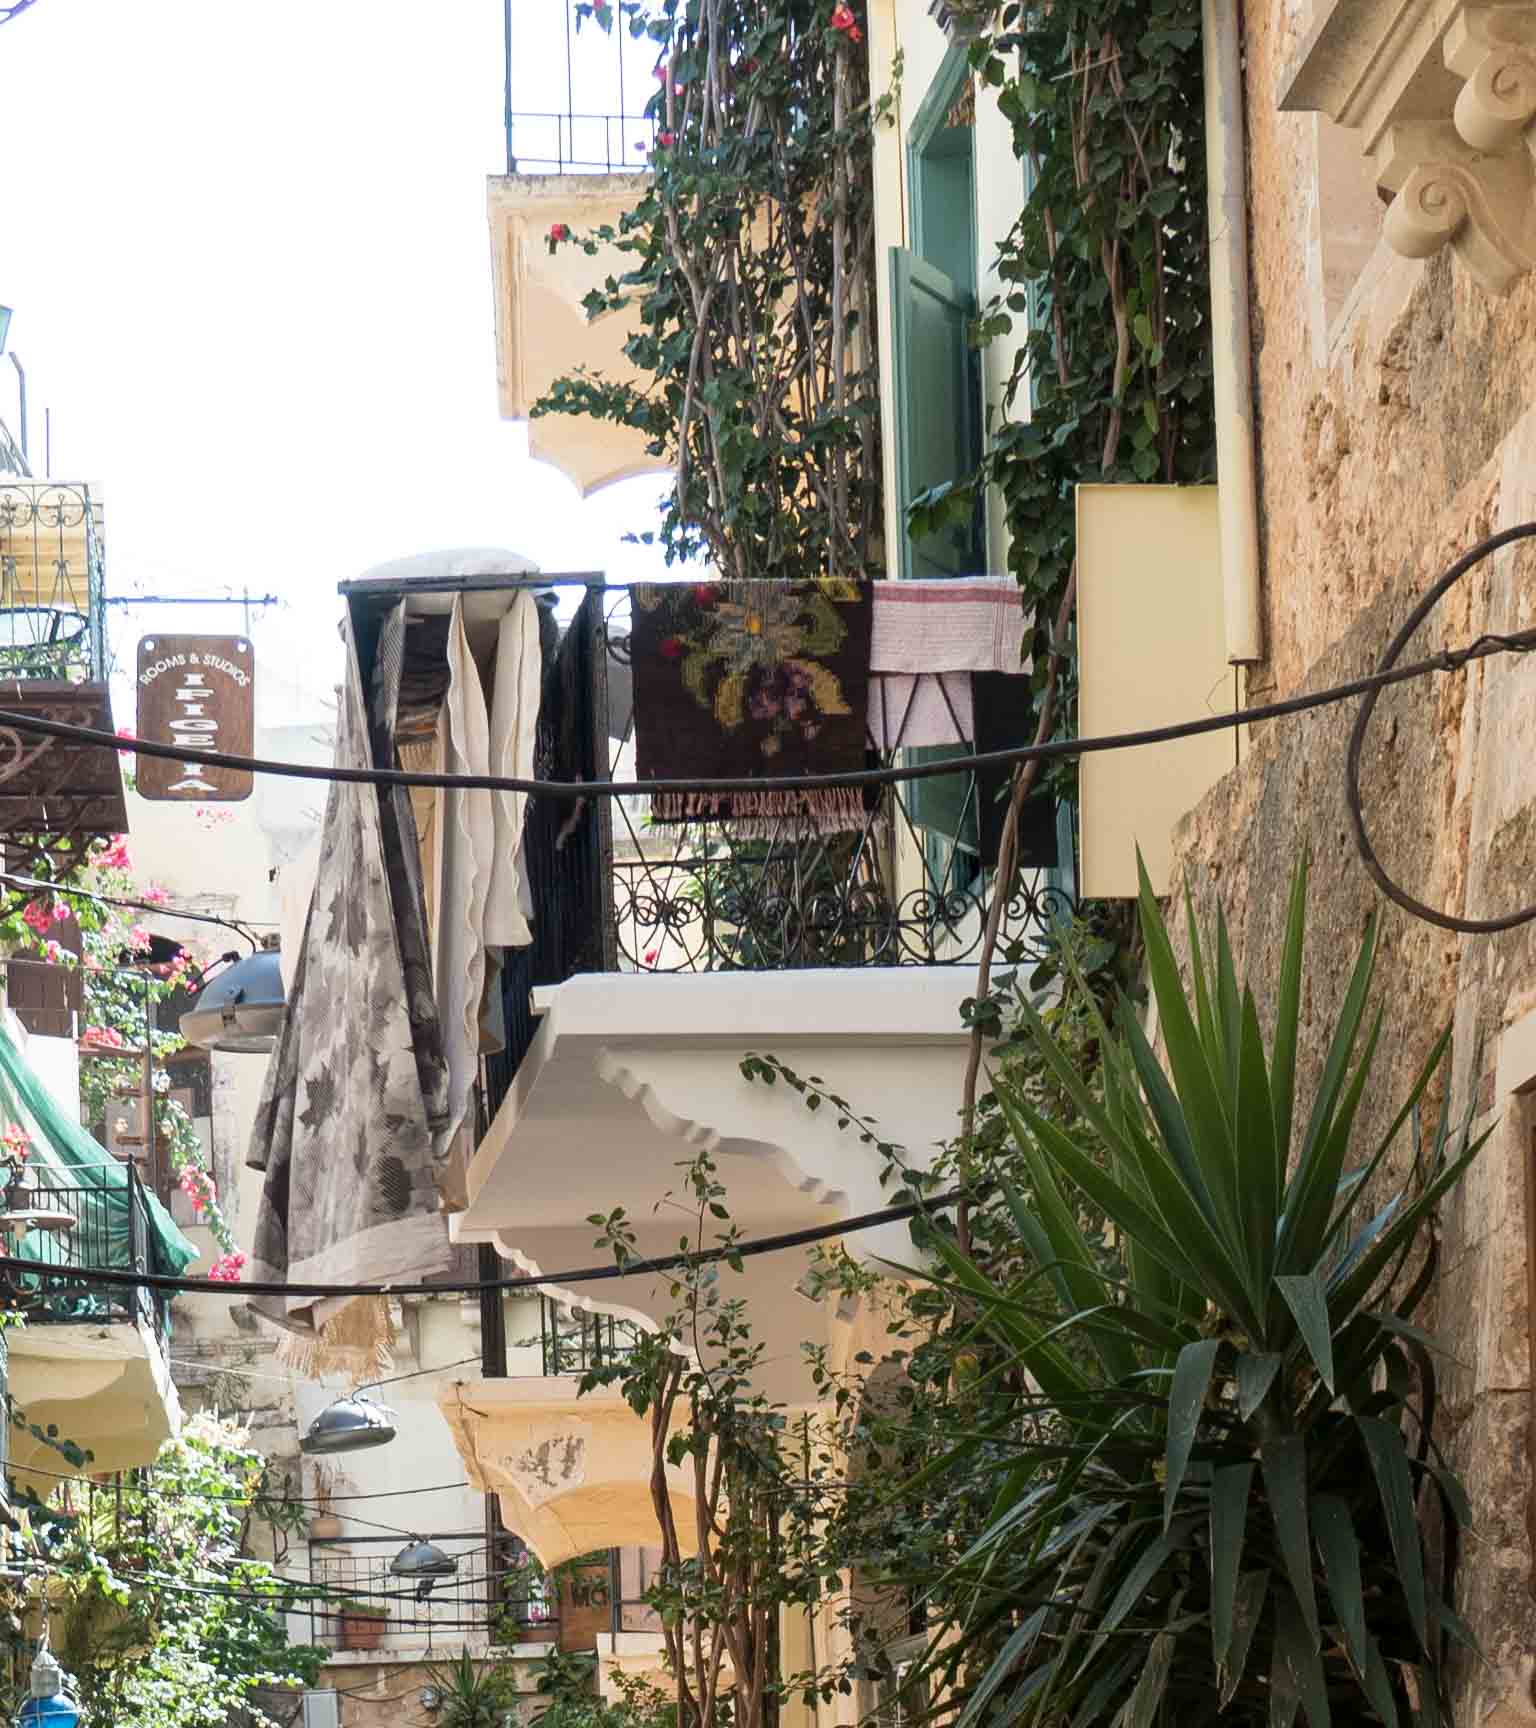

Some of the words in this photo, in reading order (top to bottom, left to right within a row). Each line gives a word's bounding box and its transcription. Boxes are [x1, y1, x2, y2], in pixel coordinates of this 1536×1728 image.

[139, 654, 185, 686] ROOMS
[189, 653, 199, 664] &
[203, 653, 251, 687] STUDIOS
[168, 673, 218, 790] IFIGEIA
